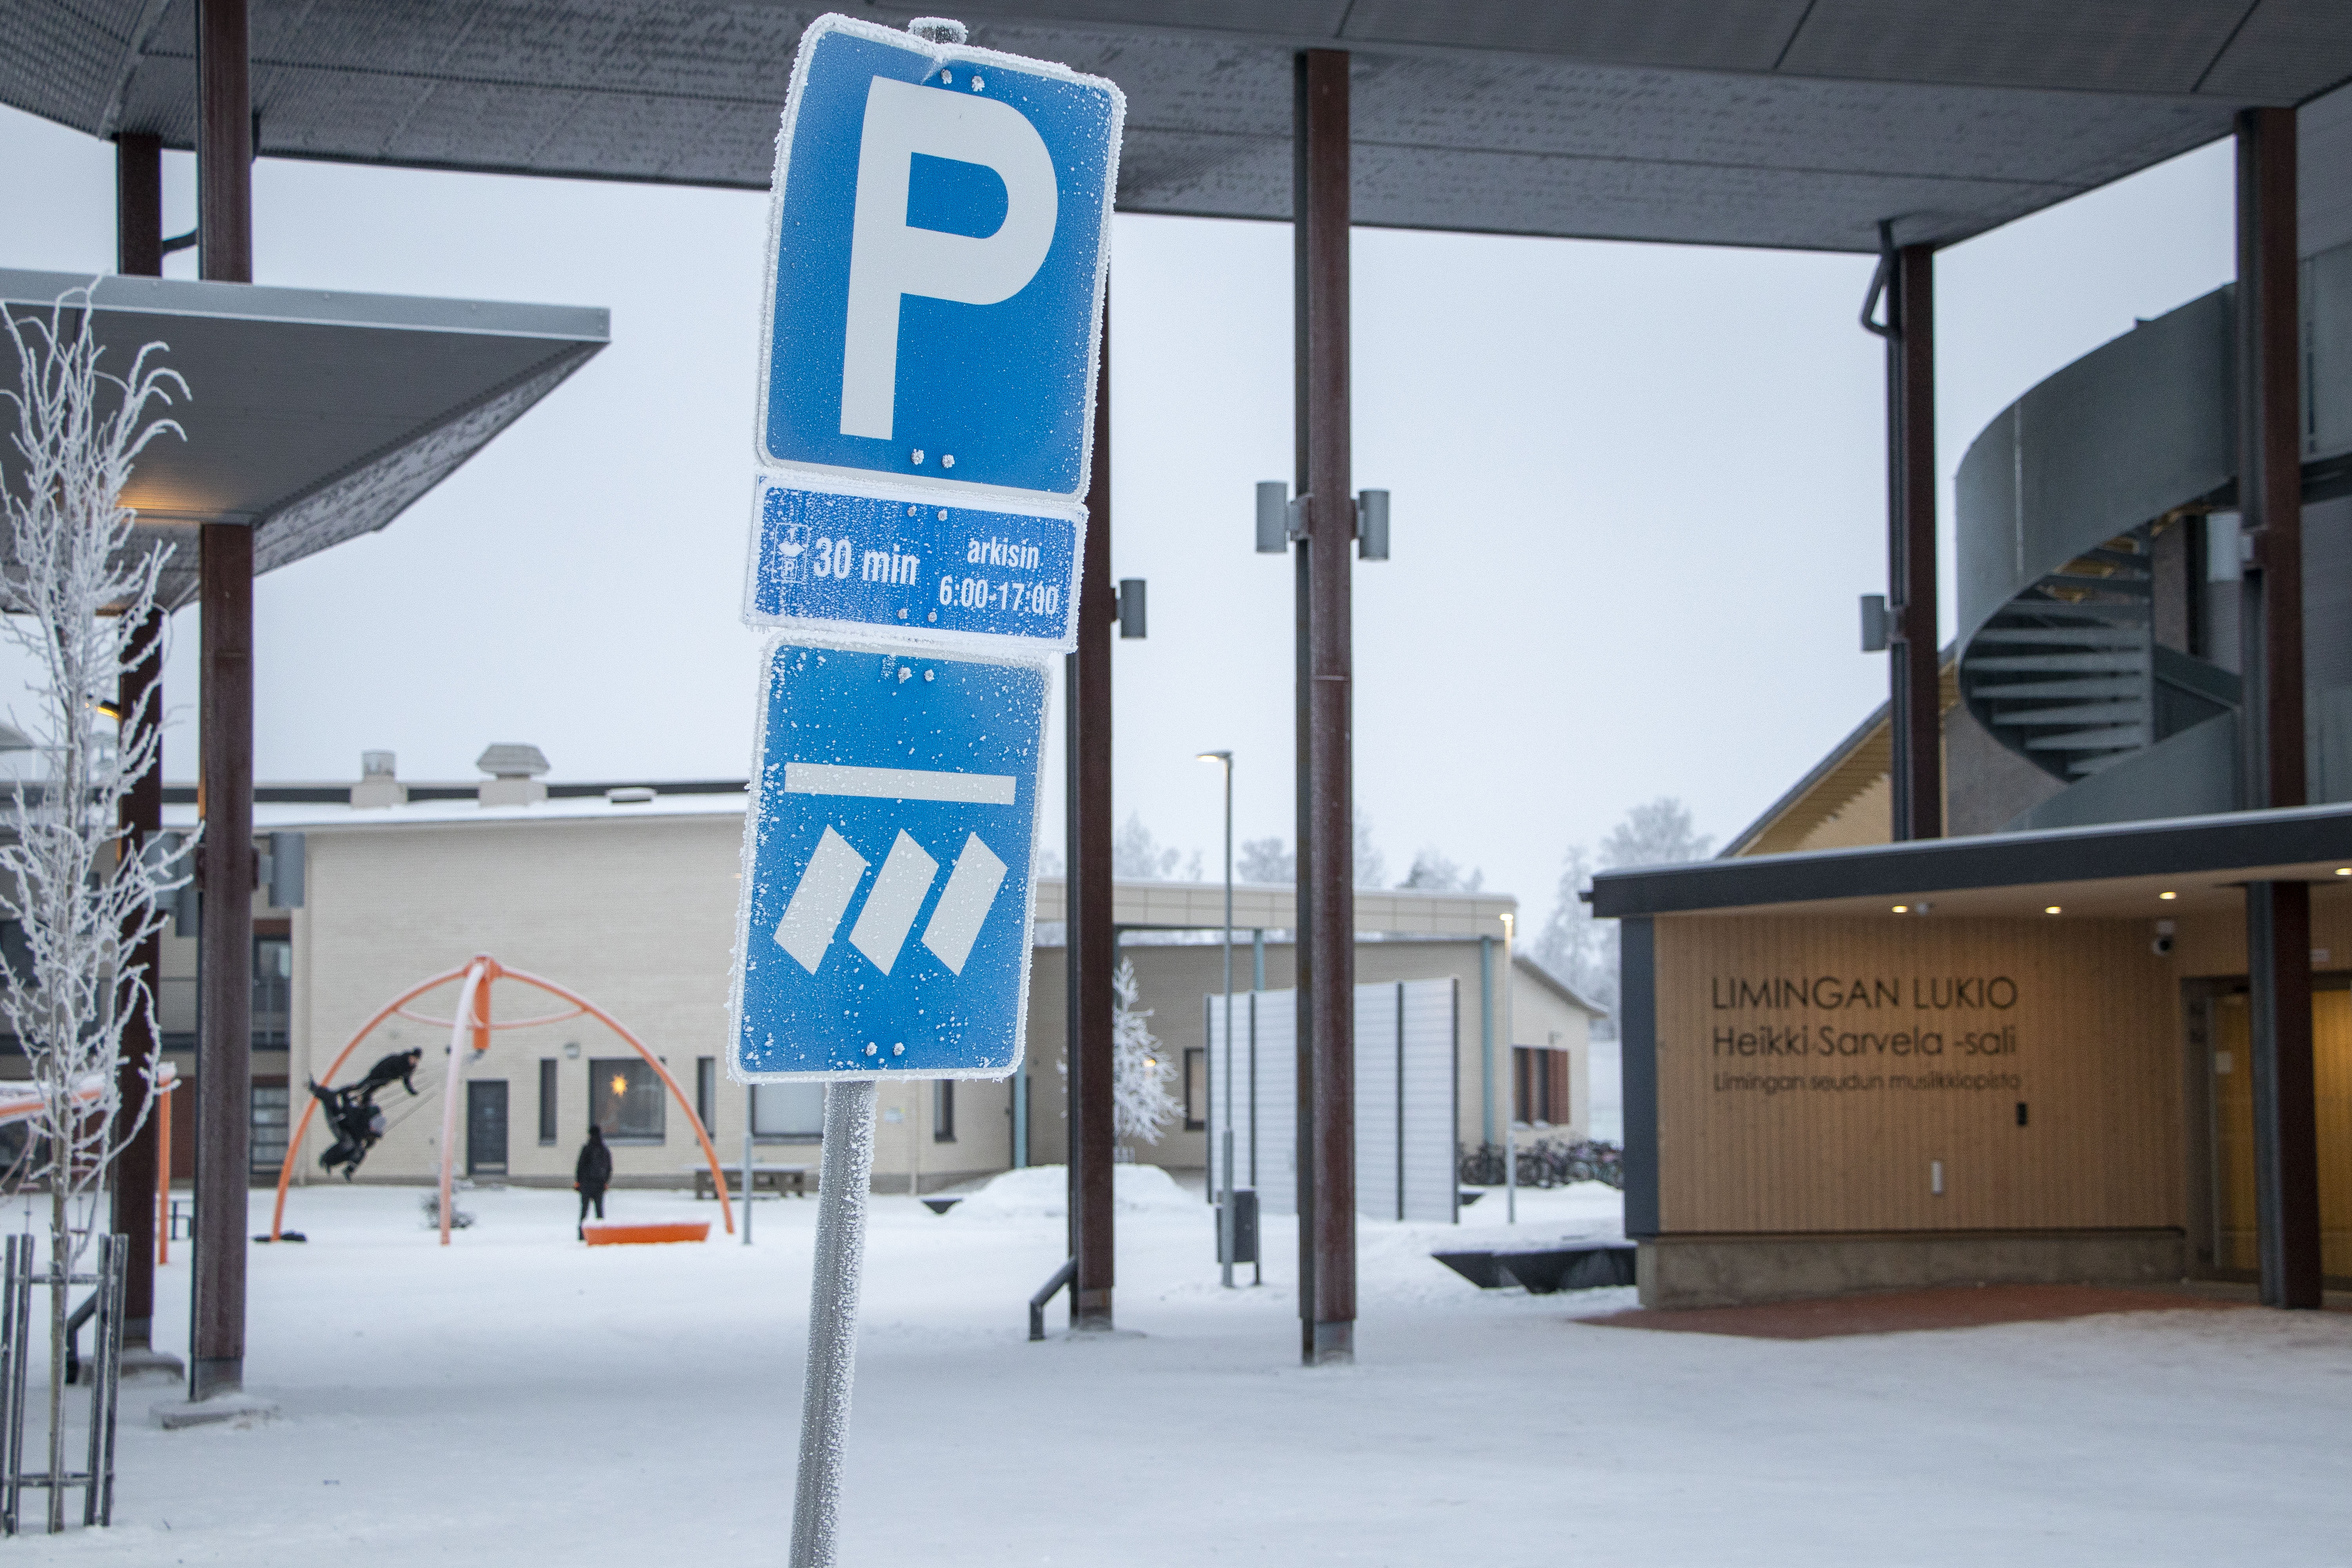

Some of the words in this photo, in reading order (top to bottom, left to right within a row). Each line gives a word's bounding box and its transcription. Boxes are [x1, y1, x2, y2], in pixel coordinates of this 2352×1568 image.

[840, 75, 1058, 440] P
[814, 537, 851, 579] 30
[862, 543, 918, 586] min
[967, 536, 1039, 569] arkisin
[940, 575, 1058, 615] 6:00-17:00
[1712, 976, 1900, 1010] LIMINGAN
[1913, 975, 2018, 1010] LUKIO
[1713, 1026, 1808, 1056] Heikki
[1818, 1025, 1943, 1056] Sarvela
[1954, 1025, 2016, 1056] -sali
[1713, 1071, 1806, 1095] Limingan
